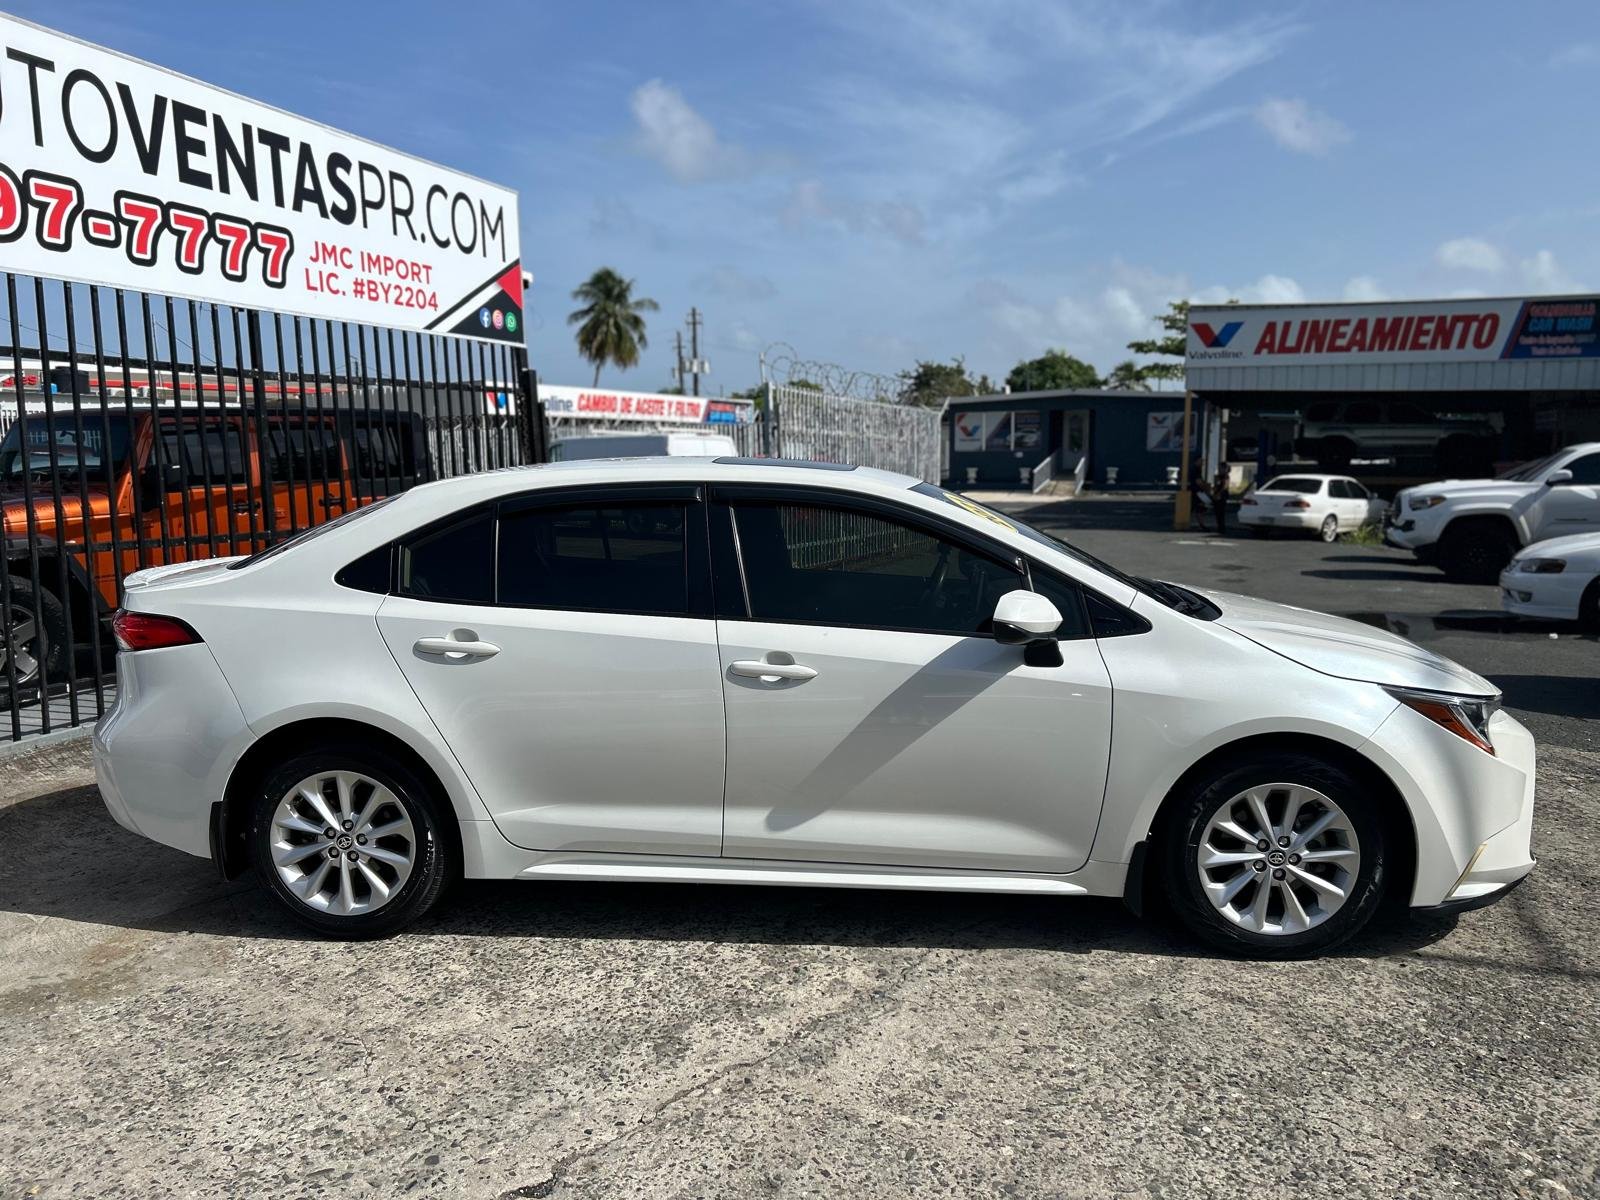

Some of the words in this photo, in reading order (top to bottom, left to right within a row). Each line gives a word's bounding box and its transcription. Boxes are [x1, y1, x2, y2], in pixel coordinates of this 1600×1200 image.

[0, 46, 506, 262] TOVENTASPR.COM
[309, 240, 353, 269] JMC
[360, 250, 432, 285] IMPORT
[304, 267, 346, 296] LIC.
[353, 277, 438, 312] #BY2204
[1253, 312, 1500, 355] ALINEAMIENTO
[577, 393, 617, 413] CAMBIO
[620, 397, 633, 414] DE
[635, 398, 664, 416] ACEITE
